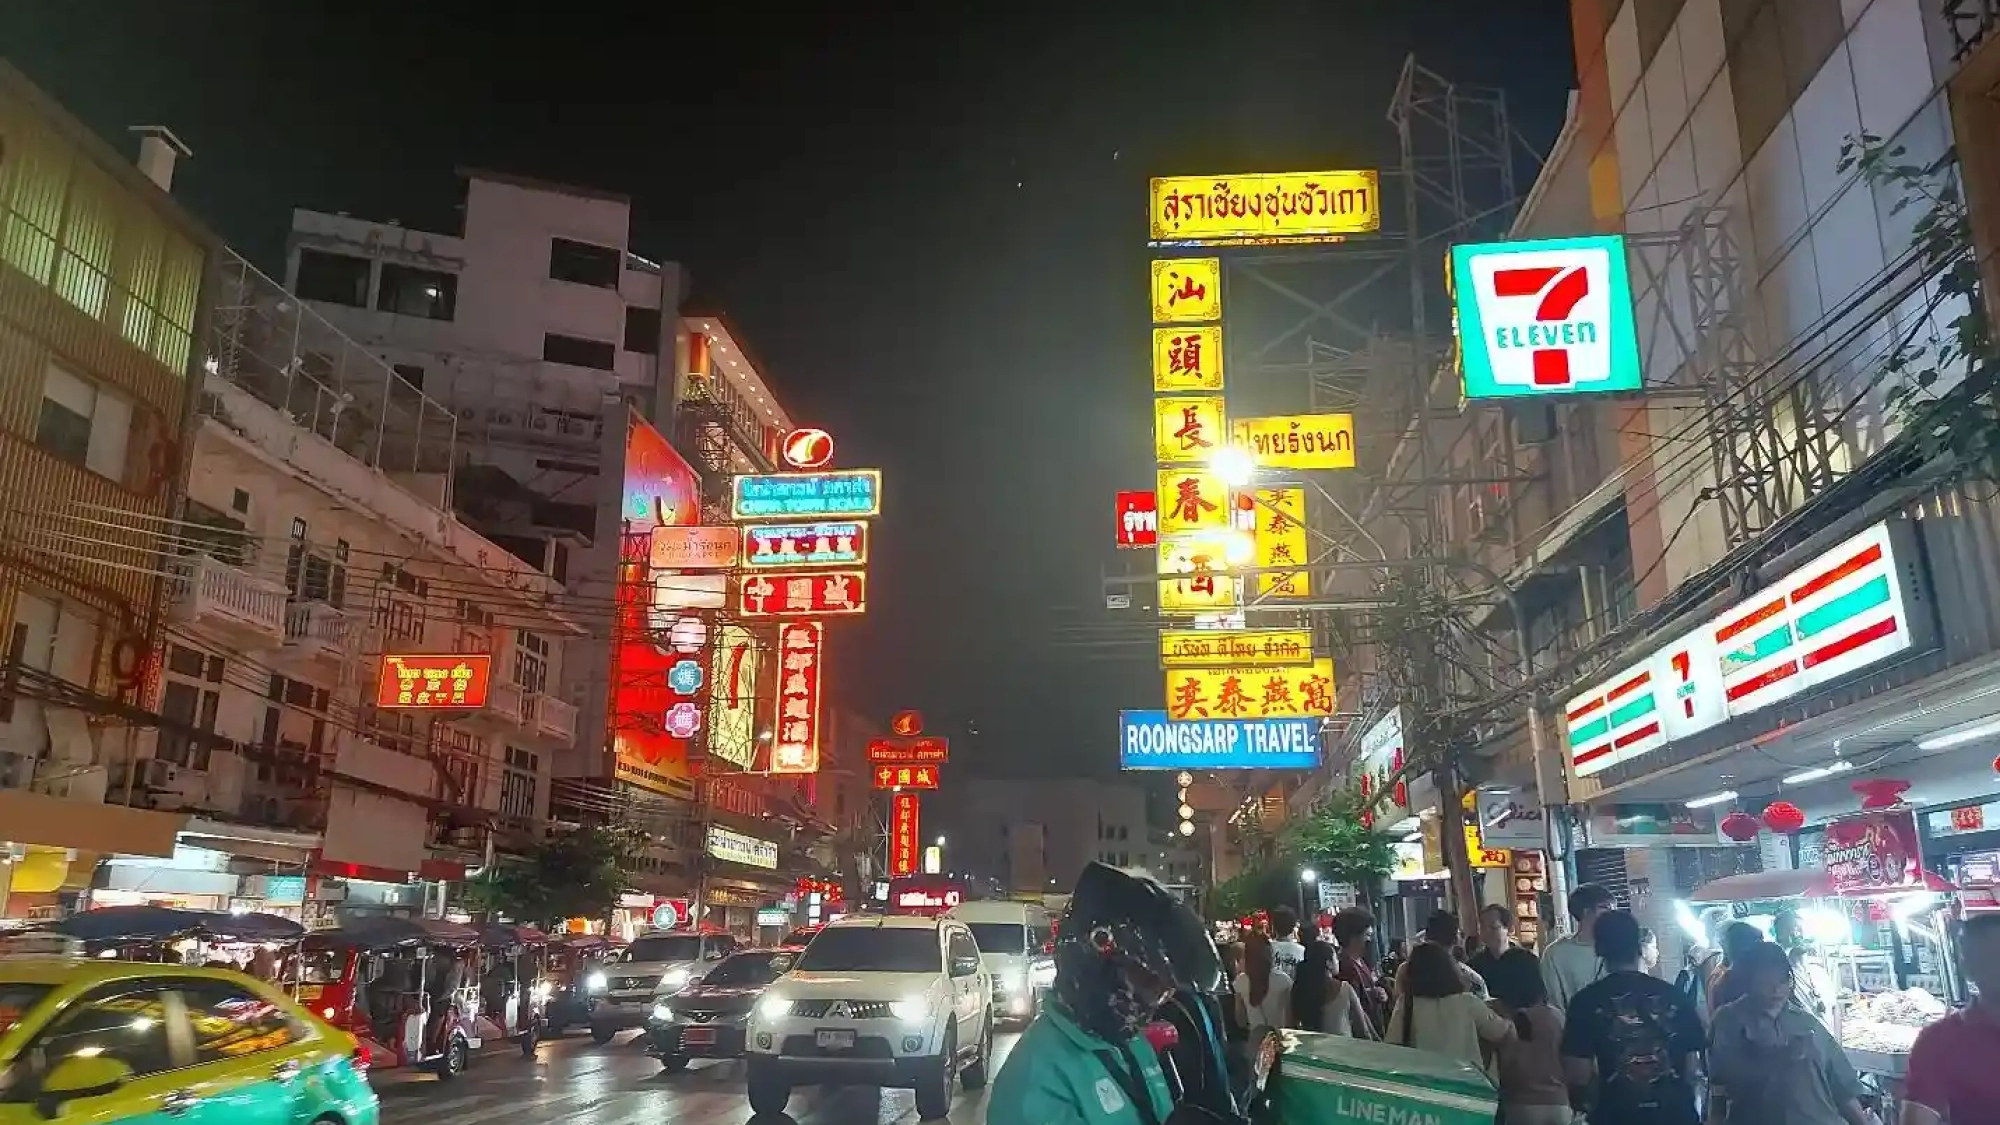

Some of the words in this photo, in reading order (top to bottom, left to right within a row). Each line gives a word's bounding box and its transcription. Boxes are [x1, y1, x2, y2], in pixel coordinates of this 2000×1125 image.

[747, 574, 854, 613] 中國城
[1127, 724, 1238, 754] ROONGSARP
[1244, 722, 1315, 753] TRAVEL
[879, 768, 931, 785] 中國城
